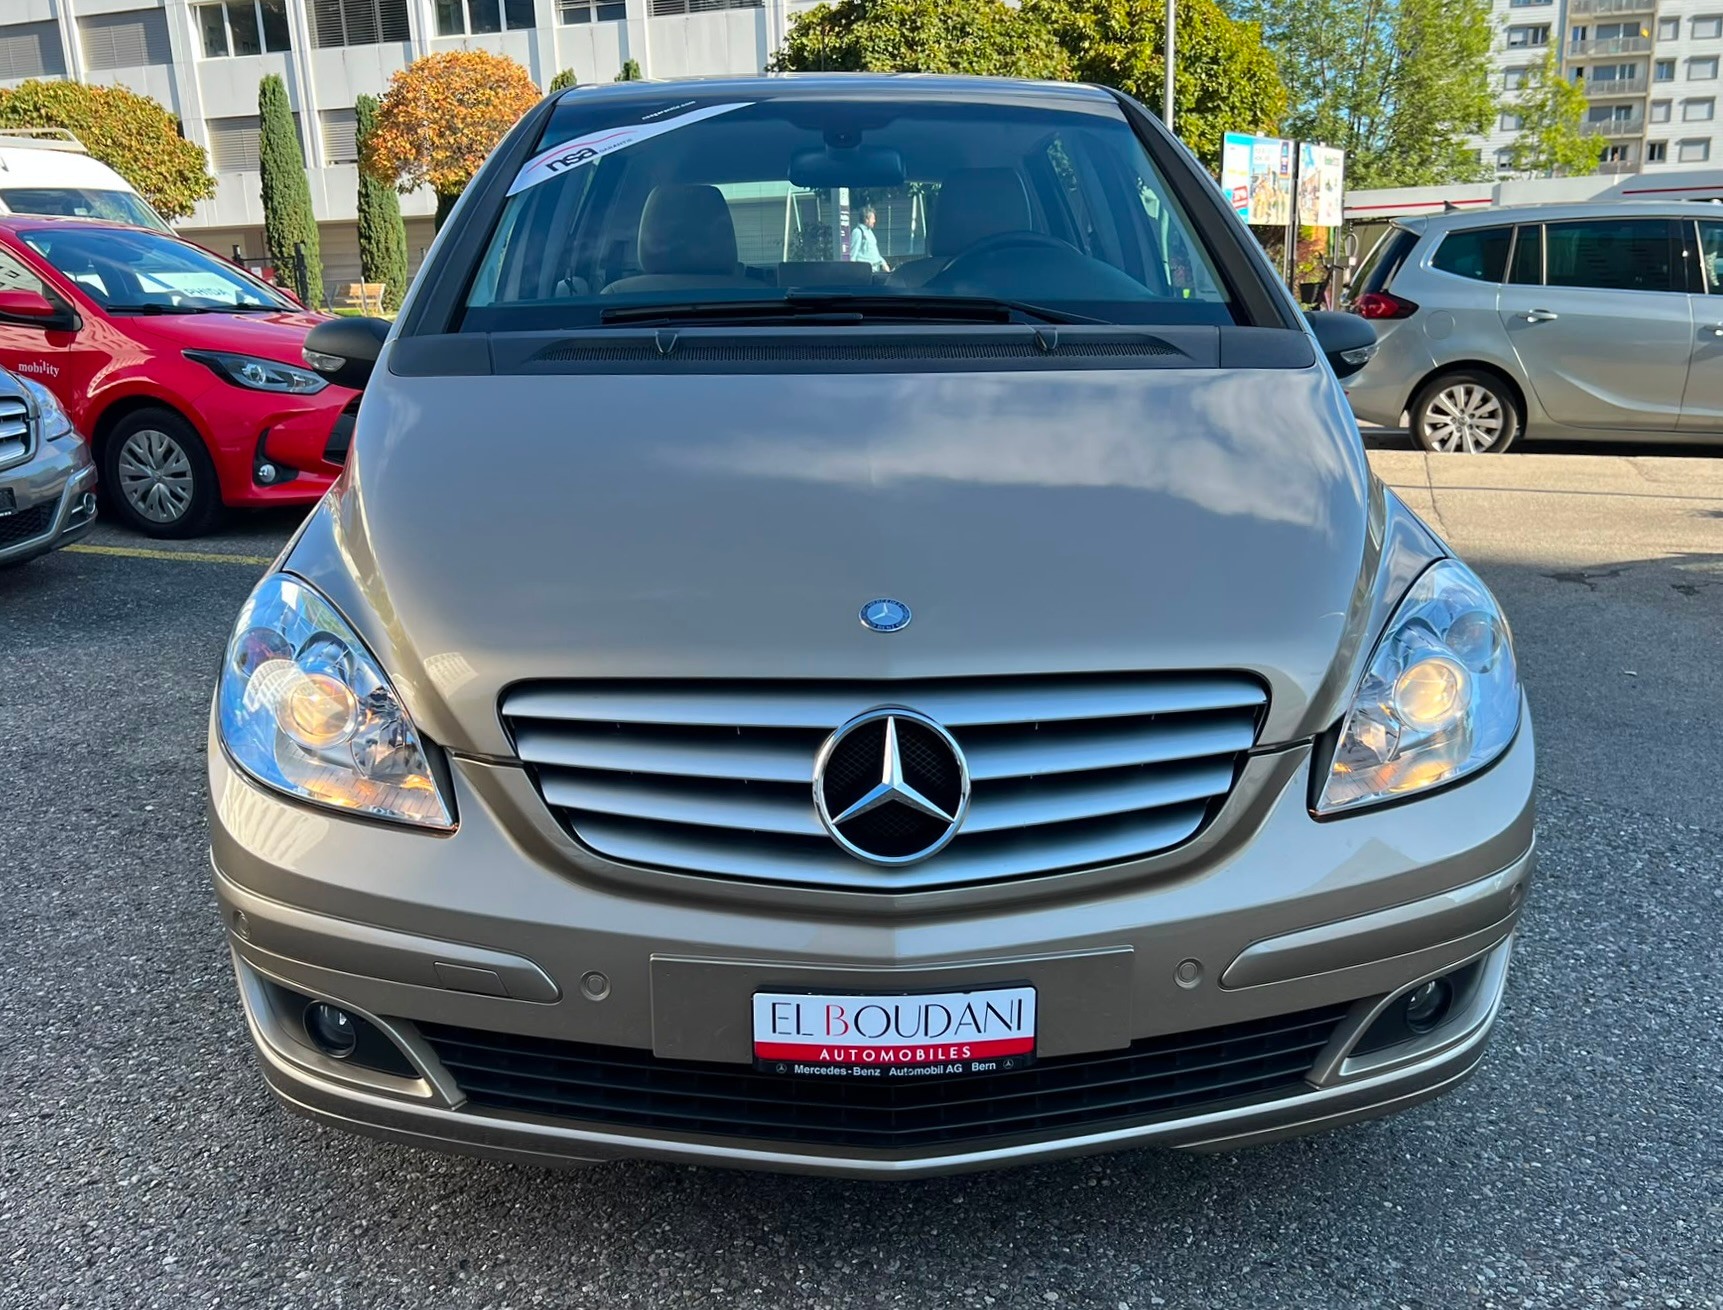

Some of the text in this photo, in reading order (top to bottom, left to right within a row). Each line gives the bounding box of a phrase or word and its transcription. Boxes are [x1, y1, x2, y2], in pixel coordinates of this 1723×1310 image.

[545, 147, 598, 172] nsa
[18, 359, 60, 378] mobility
[771, 998, 1022, 1039] EL BOUDANI
[819, 1046, 971, 1062] AUTOMOBILES
[794, 1064, 881, 1077] Mercedes-Benz
[946, 1063, 962, 1073] AG
[971, 1061, 996, 1072] Bern
